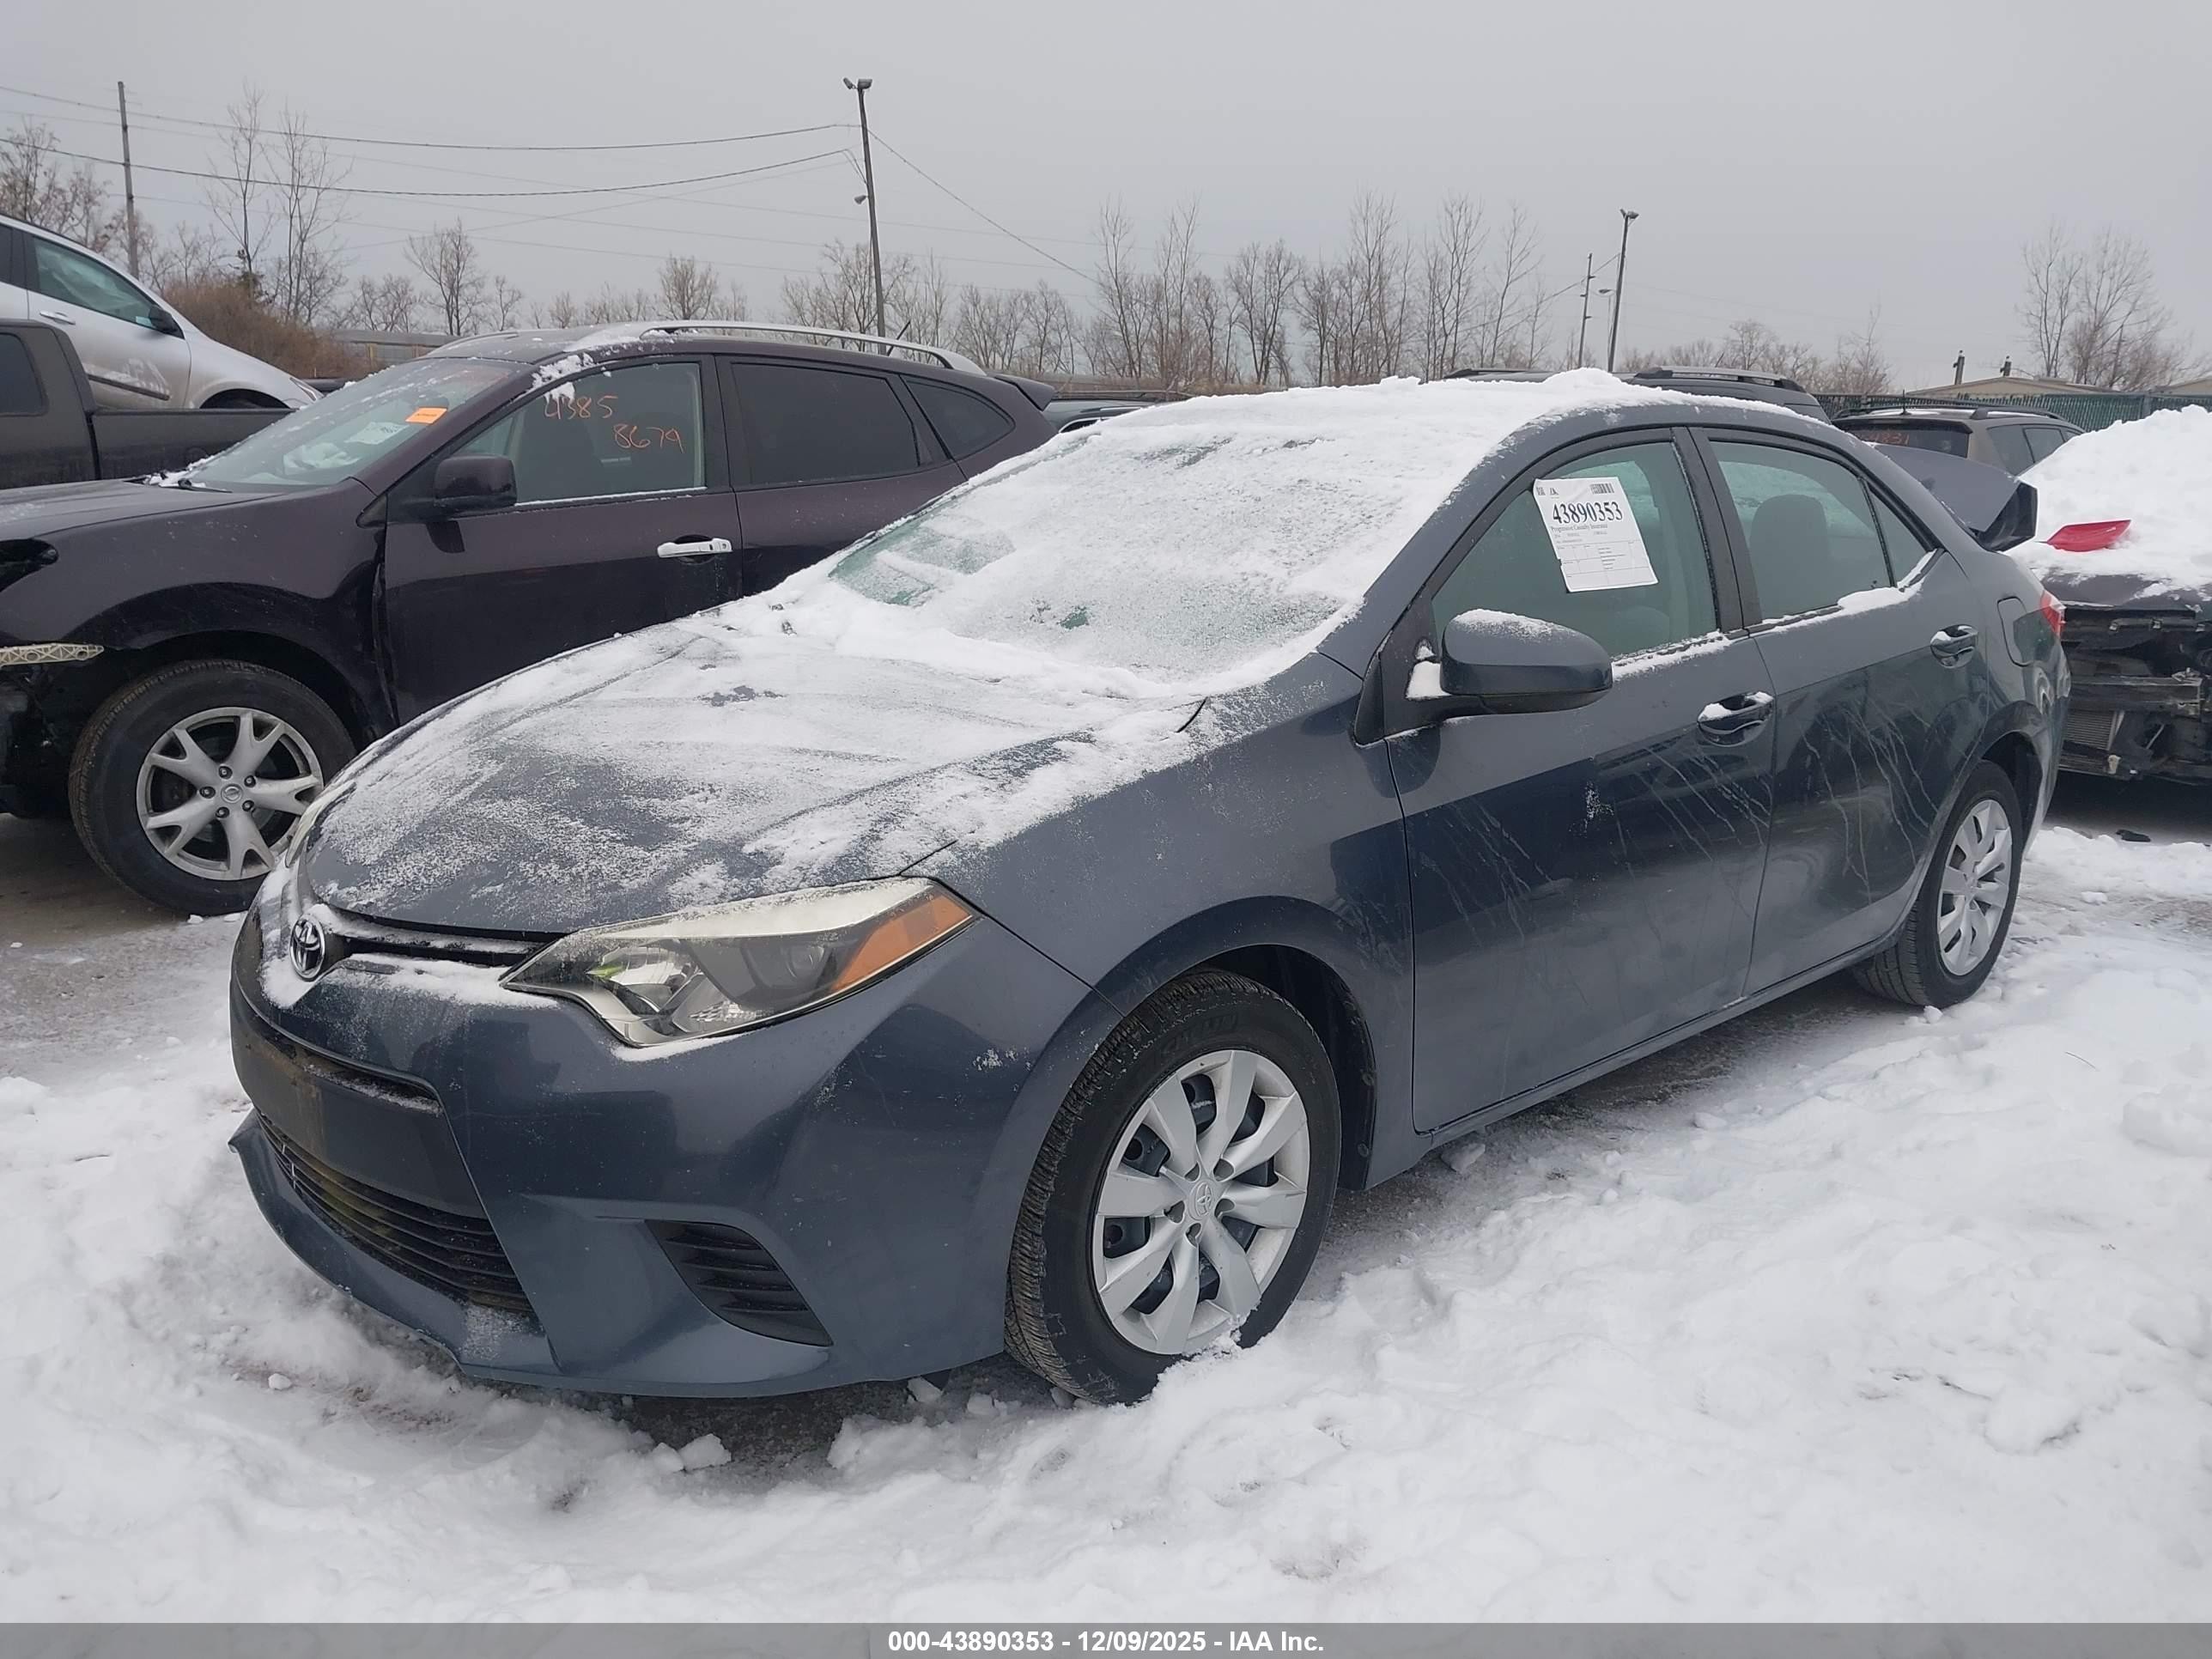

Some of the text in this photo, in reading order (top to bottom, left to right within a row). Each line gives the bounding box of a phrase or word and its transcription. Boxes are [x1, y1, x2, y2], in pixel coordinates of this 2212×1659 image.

[544, 395, 618, 420] 4385
[613, 423, 684, 453] 8679
[1553, 501, 1623, 524] 43890353
